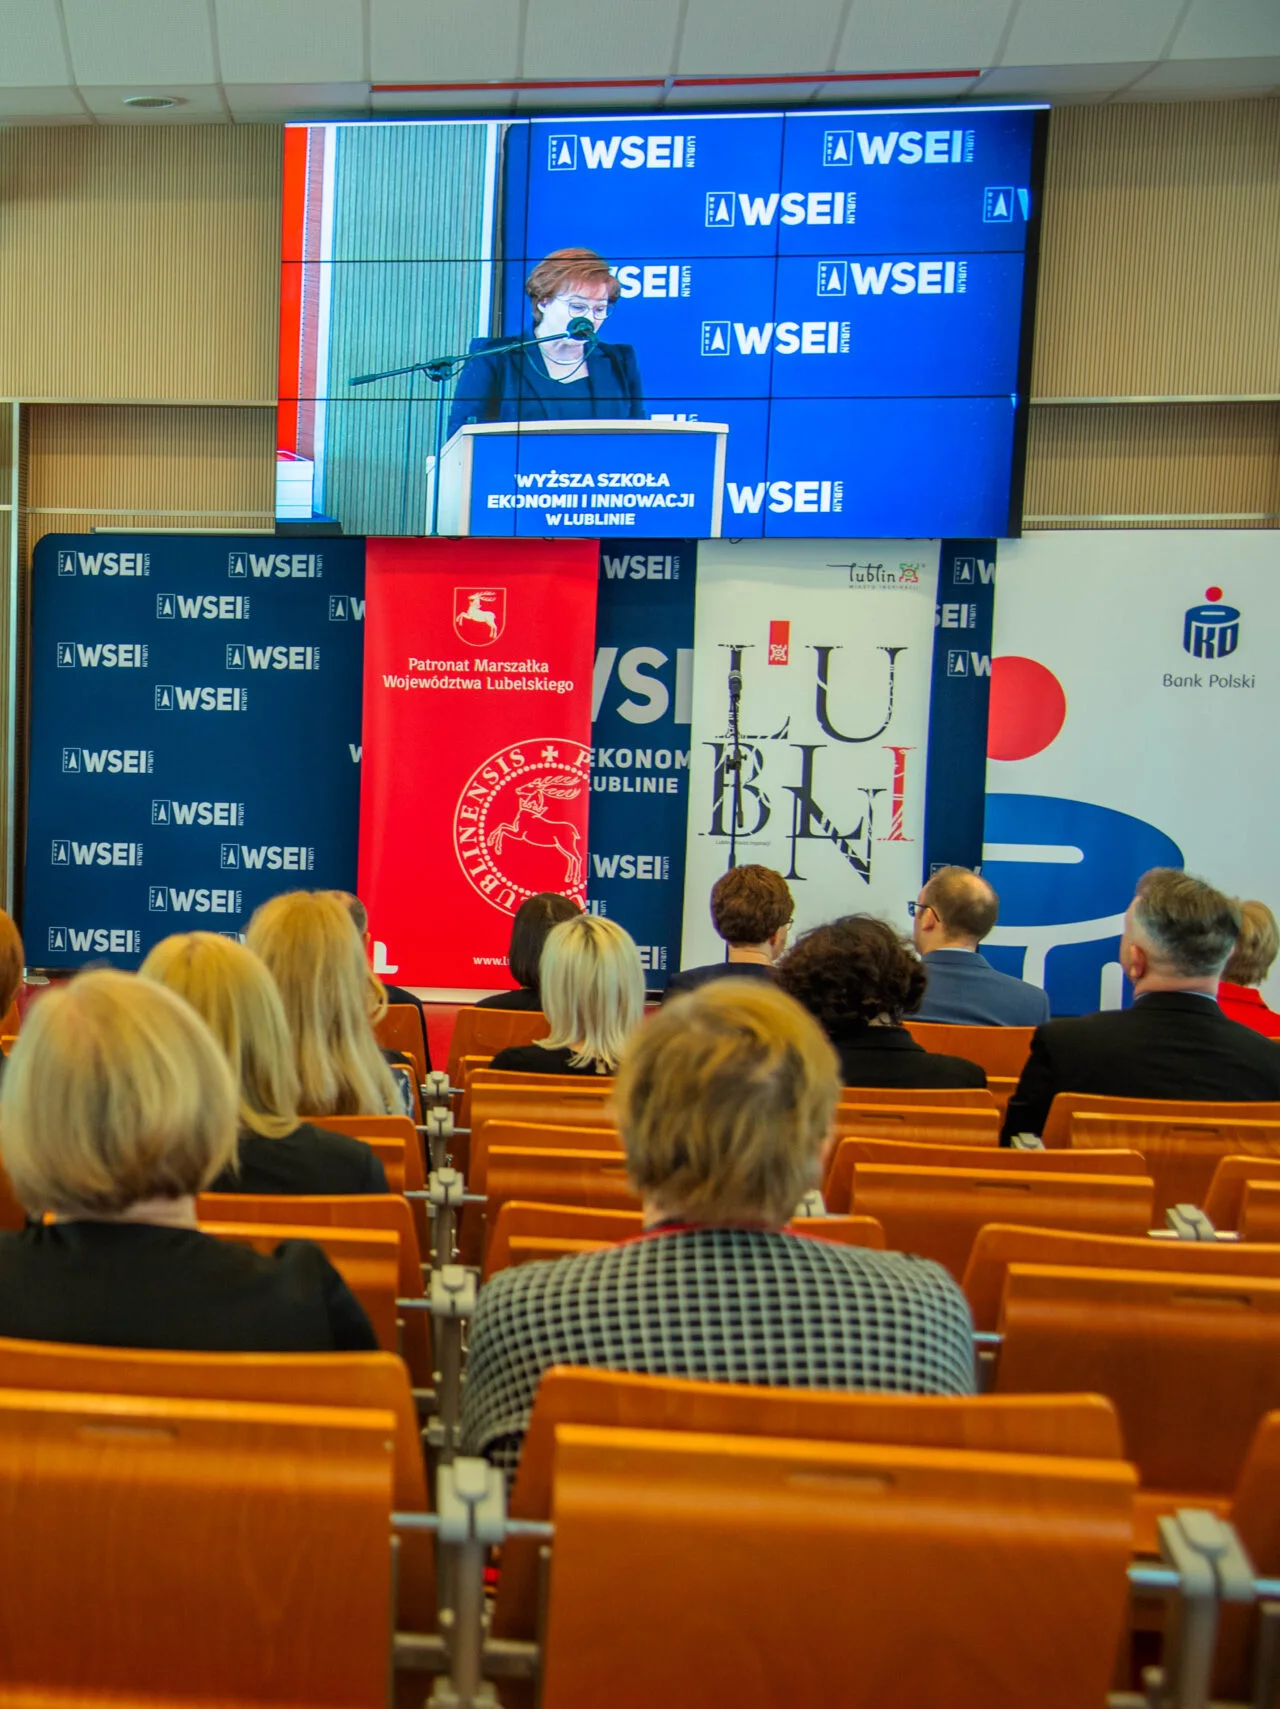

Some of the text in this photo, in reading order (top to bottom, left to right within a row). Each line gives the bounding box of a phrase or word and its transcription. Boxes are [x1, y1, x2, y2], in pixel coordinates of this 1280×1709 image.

[580, 136, 684, 168] WSEI
[857, 131, 962, 164] WSEI
[739, 192, 844, 225] WSEI
[608, 266, 679, 298] SEI
[851, 262, 955, 294] WSEI
[734, 322, 838, 354] WSEI
[515, 470, 670, 487] WYŻSZA SZKOŁA
[488, 494, 694, 508] EKONOMII I INNOWACJI
[727, 481, 831, 513] WSEI
[546, 513, 635, 525] W LUBLINIE
[78, 553, 143, 576] WSEI
[249, 554, 315, 577] WSEI
[603, 556, 671, 579] WSEI
[177, 596, 242, 619] WSEI
[77, 644, 141, 667] WSEI
[247, 646, 312, 669] WSEI
[409, 658, 549, 672] Patronat Marszałka
[382, 675, 573, 694] Województwa Lubelskiego
[1163, 674, 1255, 688] Bank Polski
[175, 687, 240, 710] WSEI
[83, 750, 146, 773] WSEI
[590, 776, 678, 793] UBLINIE
[172, 802, 237, 825] WSEI
[459, 748, 527, 910] UBLINENSIS
[72, 842, 135, 865] WSEI
[241, 846, 306, 870] WSEI
[593, 855, 661, 879] WSEI
[170, 889, 234, 913] WSEI
[69, 929, 133, 952] WSEI
